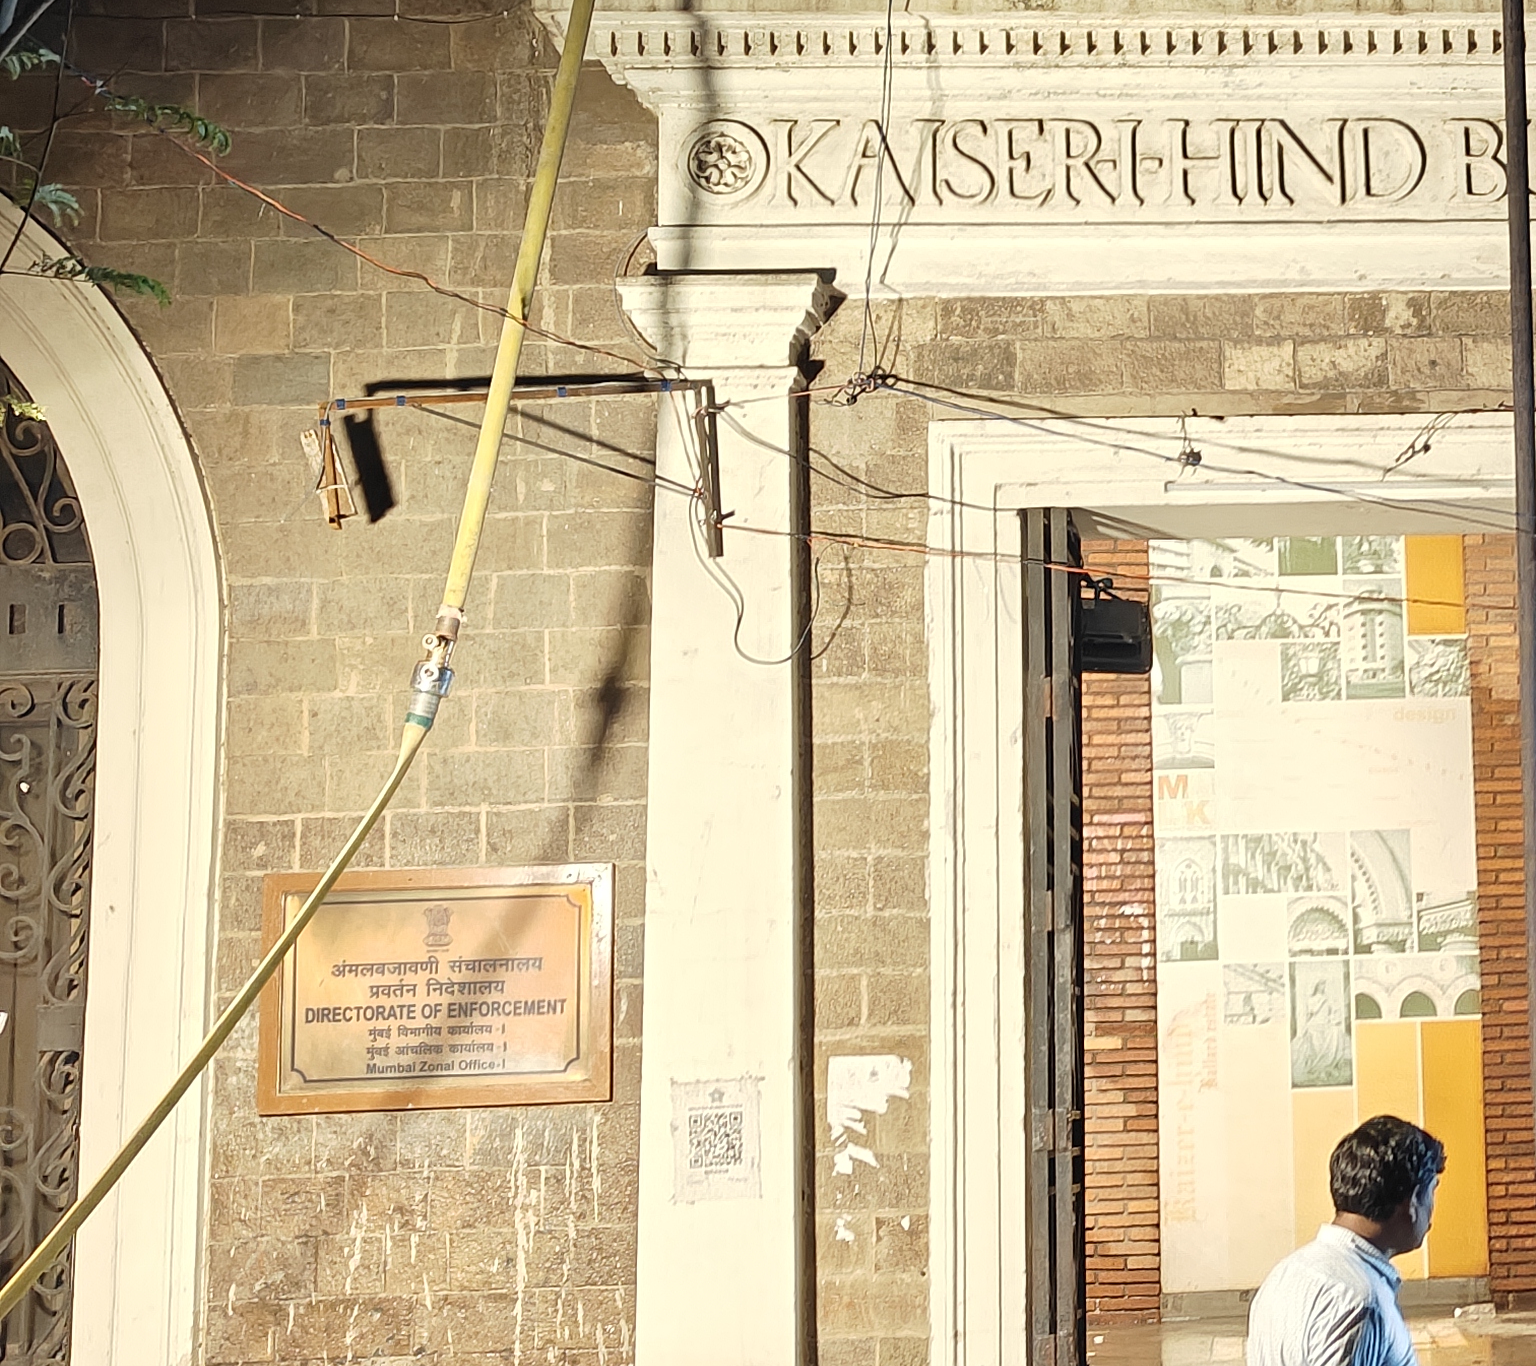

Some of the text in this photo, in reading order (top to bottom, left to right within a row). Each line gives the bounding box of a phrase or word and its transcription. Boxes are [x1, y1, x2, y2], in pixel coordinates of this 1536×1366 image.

[447, 955, 544, 975] संचालनालय
[369, 976, 506, 999] प्रवर्तन निदेशालय
[305, 998, 568, 1024] DIRECTORATE OF ENFORCEMENT
[365, 1061, 416, 1075] Mumbai
[419, 1059, 455, 1073] Zonal
